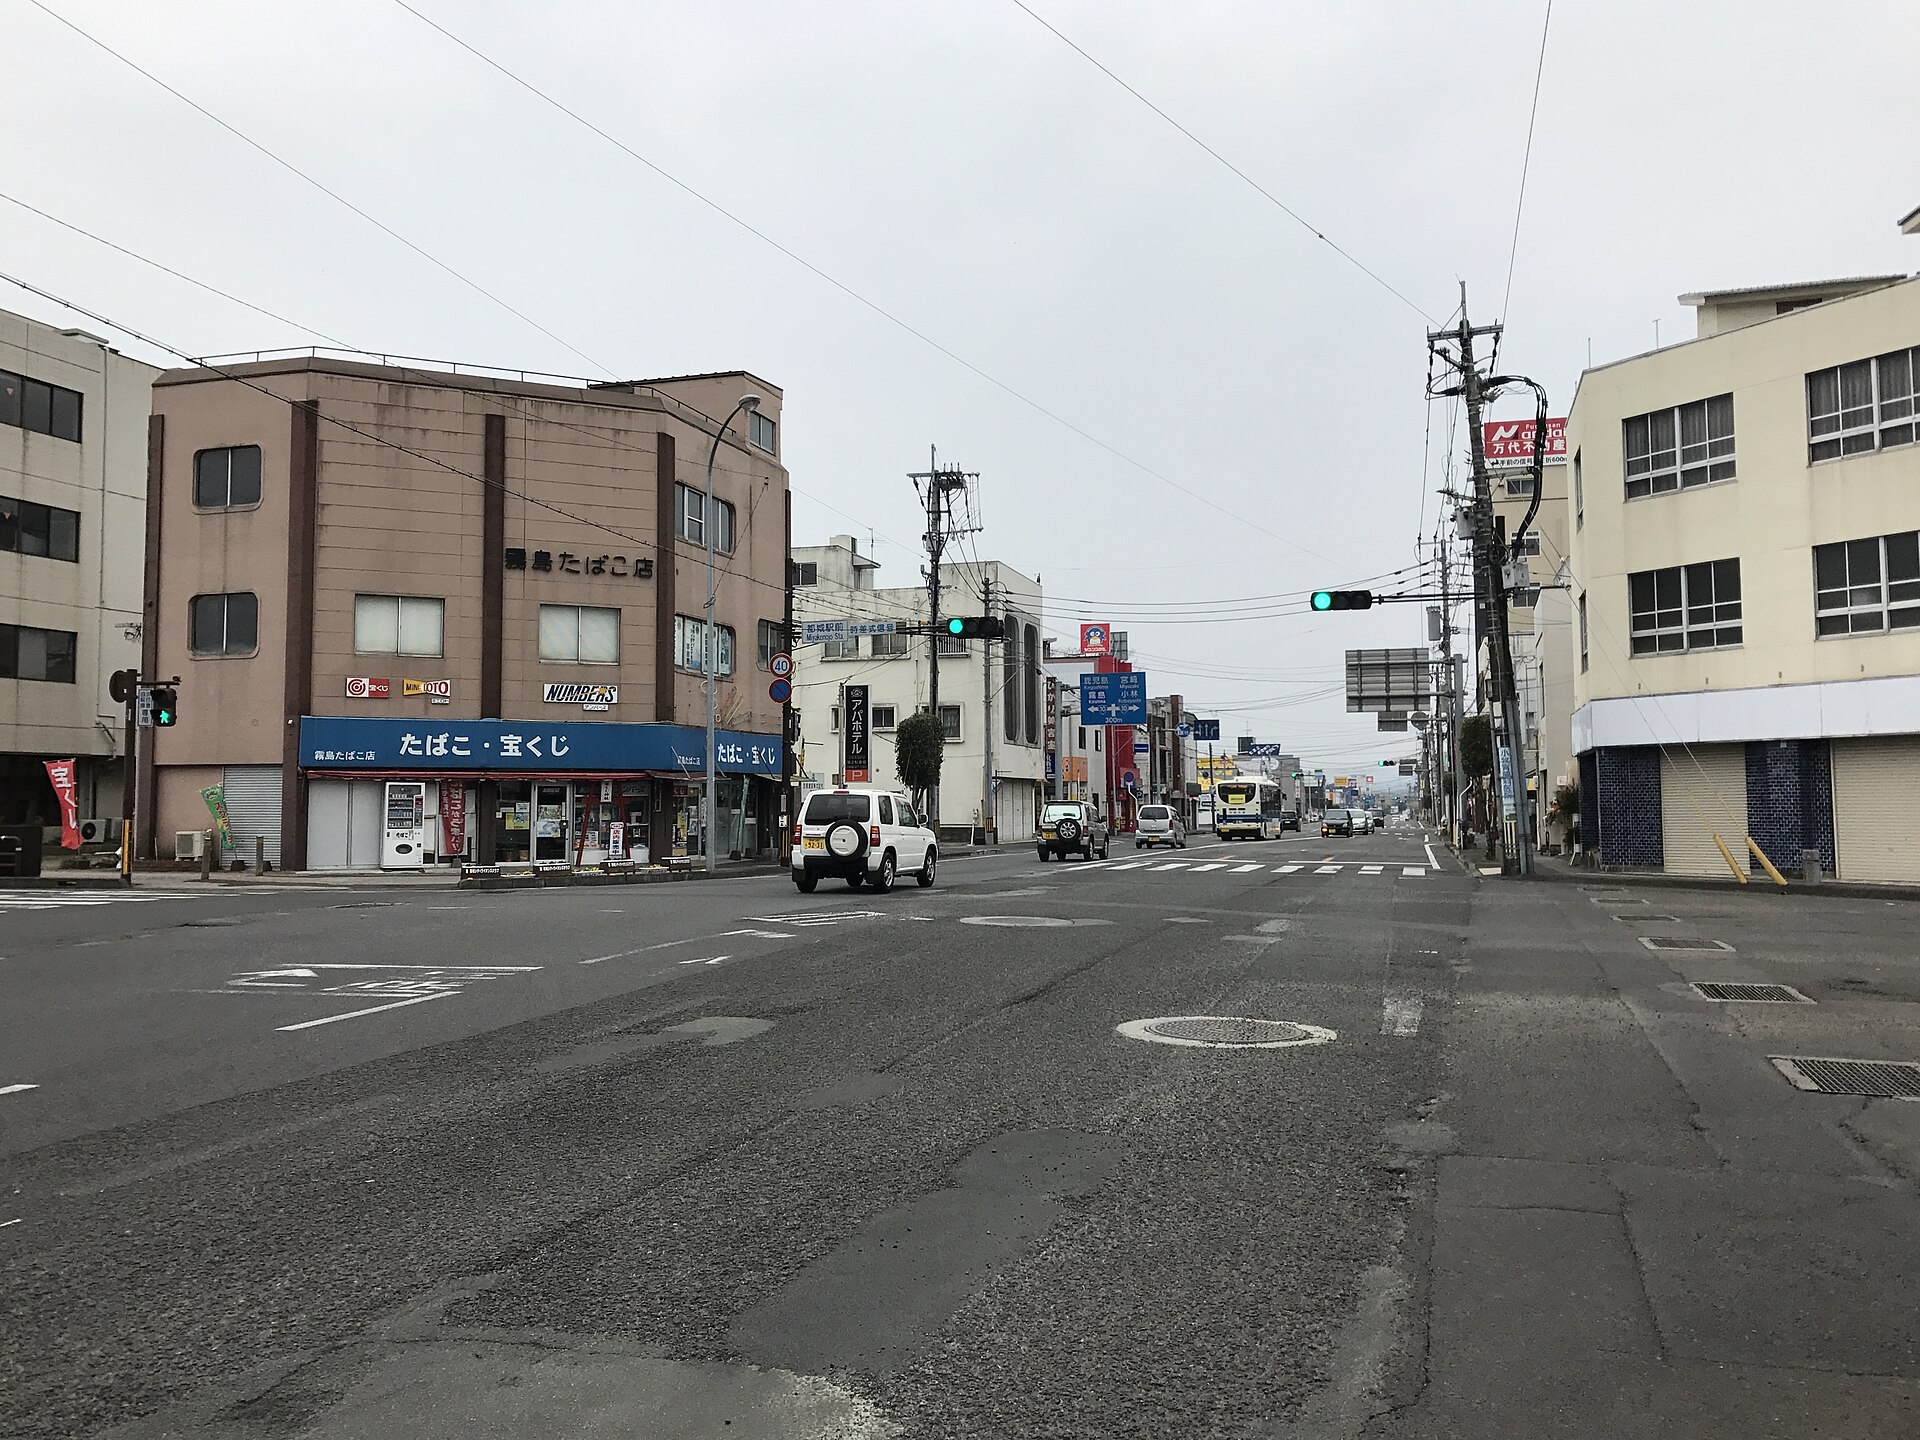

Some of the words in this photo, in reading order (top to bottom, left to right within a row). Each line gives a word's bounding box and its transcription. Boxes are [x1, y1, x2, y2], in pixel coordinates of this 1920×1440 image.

[504, 547, 655, 578] 霧島たばこ店
[807, 622, 844, 633] 都城駅前
[850, 623, 895, 634] 時差式信号
[806, 633, 833, 643] Miyakonojo
[775, 660, 788, 671] 40
[1120, 675, 1138, 684] 宮崎
[423, 681, 449, 694] LOTO
[545, 684, 617, 702] NUMBERS
[1121, 690, 1139, 698] 小林
[851, 699, 863, 754] アパホテル
[400, 733, 570, 757] たばこ・宝くじ
[314, 750, 375, 761] 霧島たばこ店
[717, 743, 775, 765] たばこ・宝くじ
[852, 770, 863, 780] P
[612, 829, 620, 854] 店内販売中
